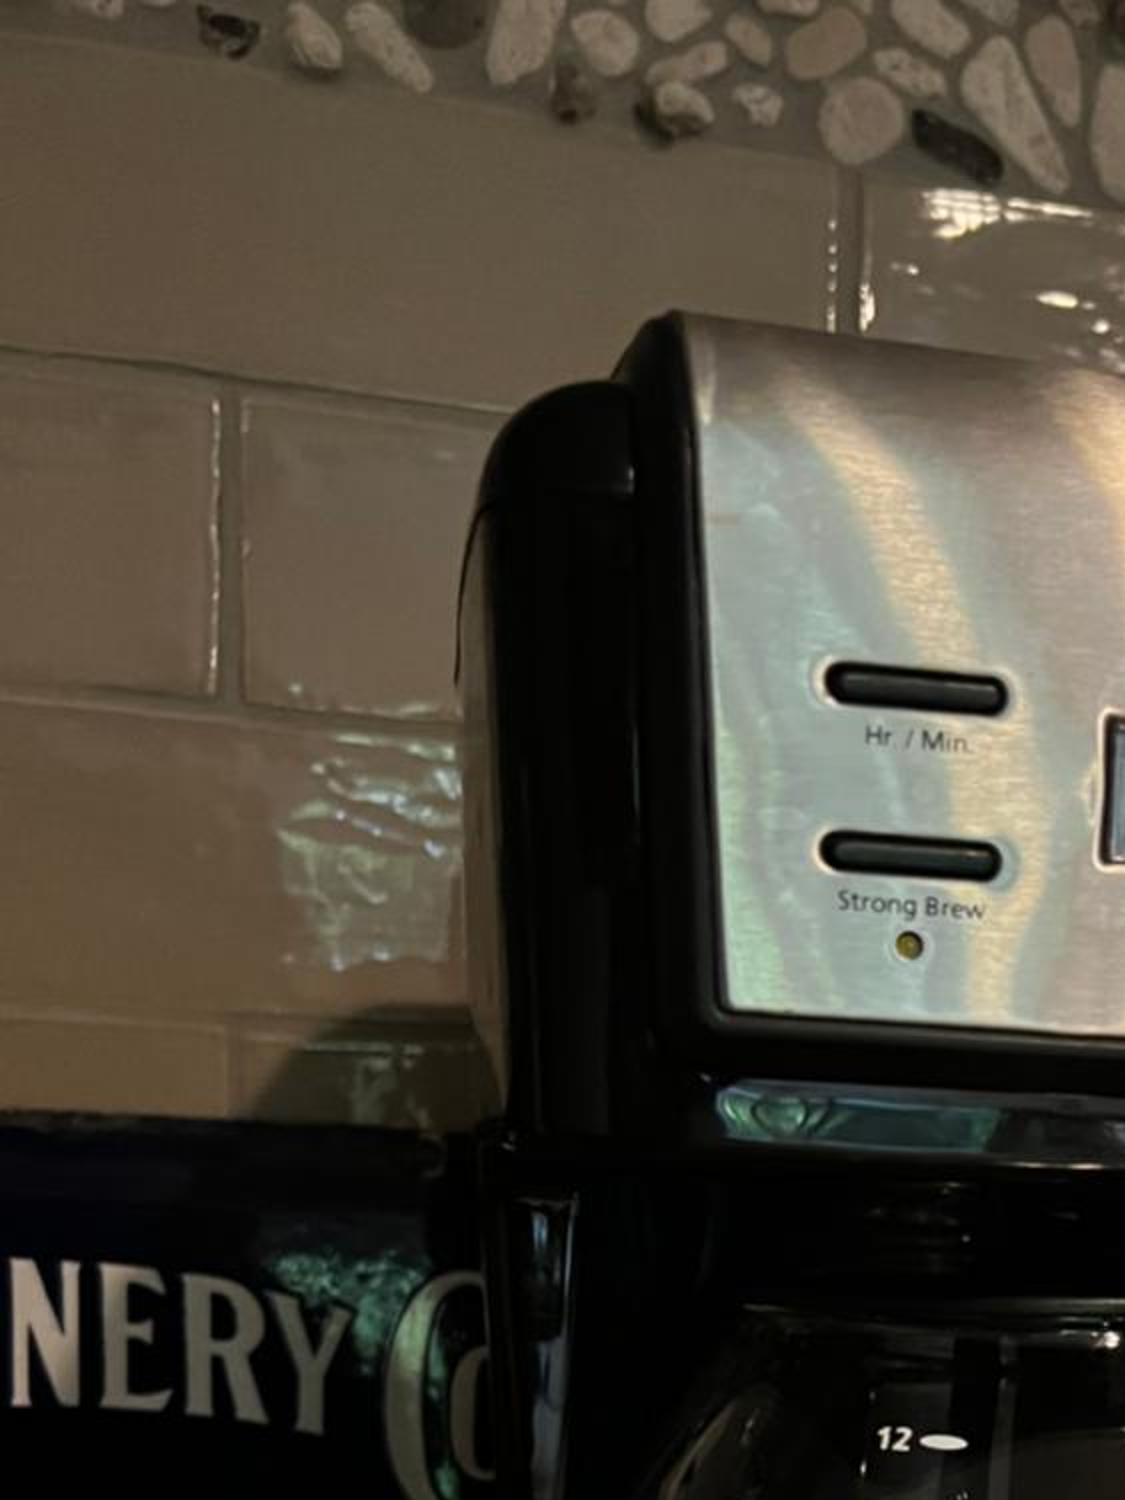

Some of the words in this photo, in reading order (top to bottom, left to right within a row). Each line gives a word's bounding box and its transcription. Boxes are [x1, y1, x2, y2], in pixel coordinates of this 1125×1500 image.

[837, 891, 917, 920] Strong
[925, 897, 985, 918] Brew
[876, 1426, 914, 1453] 12
